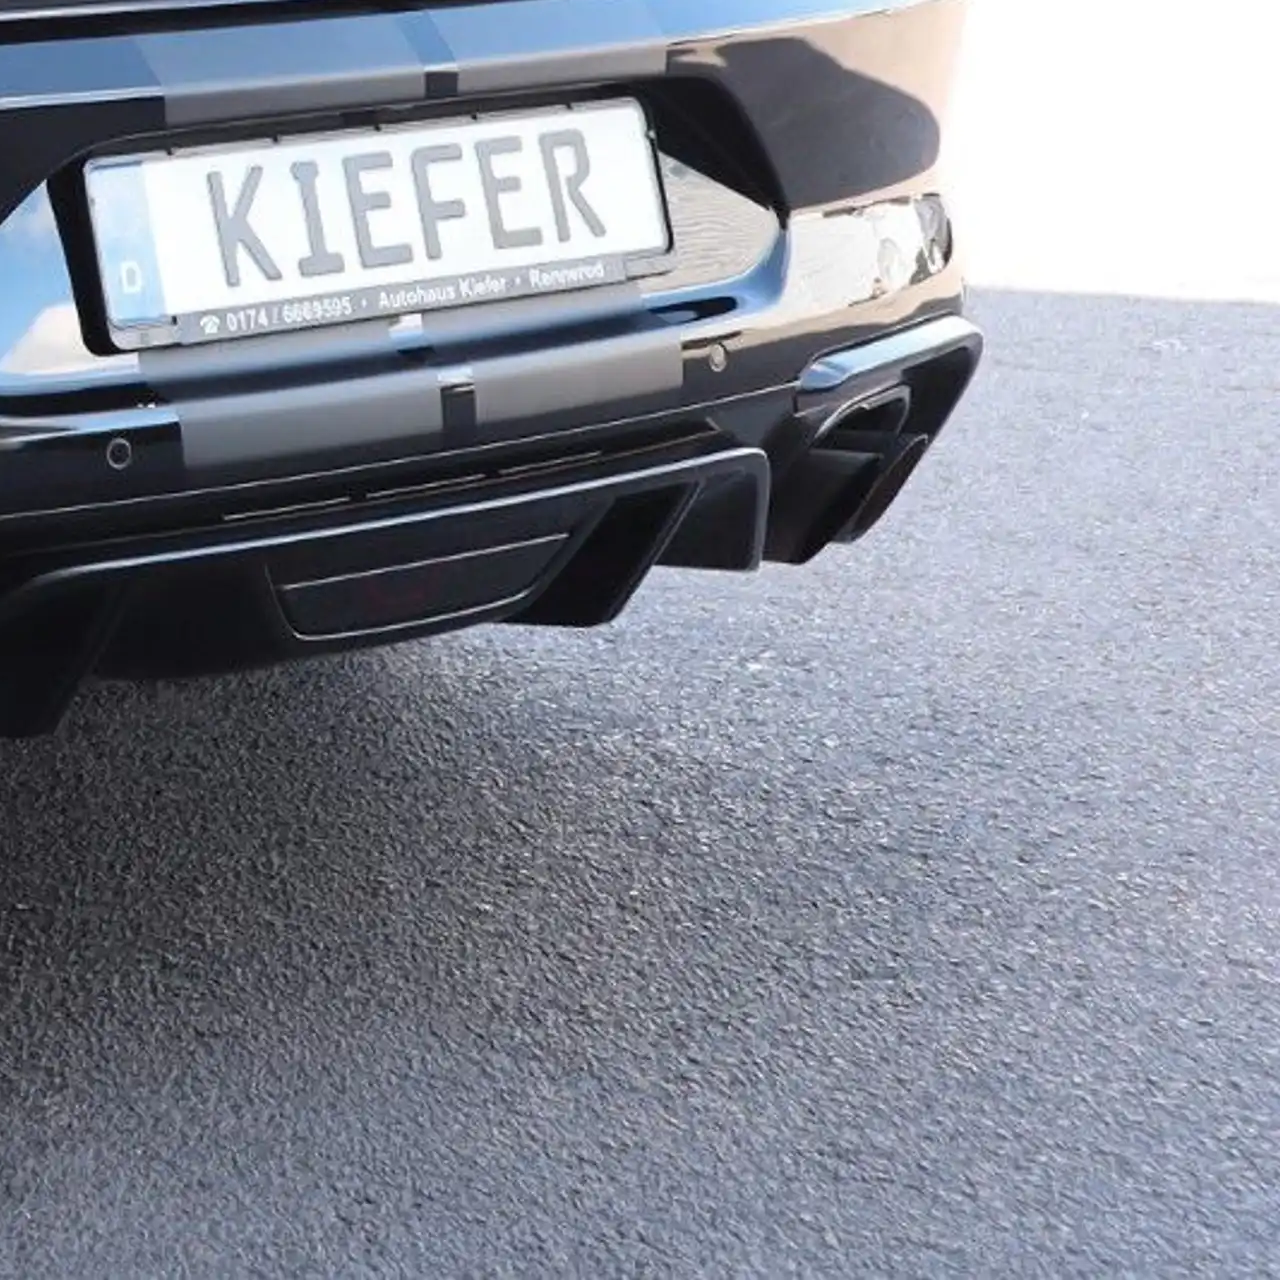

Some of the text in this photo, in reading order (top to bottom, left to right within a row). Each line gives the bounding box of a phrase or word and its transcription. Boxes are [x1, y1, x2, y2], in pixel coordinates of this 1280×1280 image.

[207, 129, 607, 288] KIEFER
[121, 261, 142, 294] D
[225, 309, 269, 332] 0174
[379, 284, 456, 310] Autohaus
[458, 275, 508, 298] Kiefer
